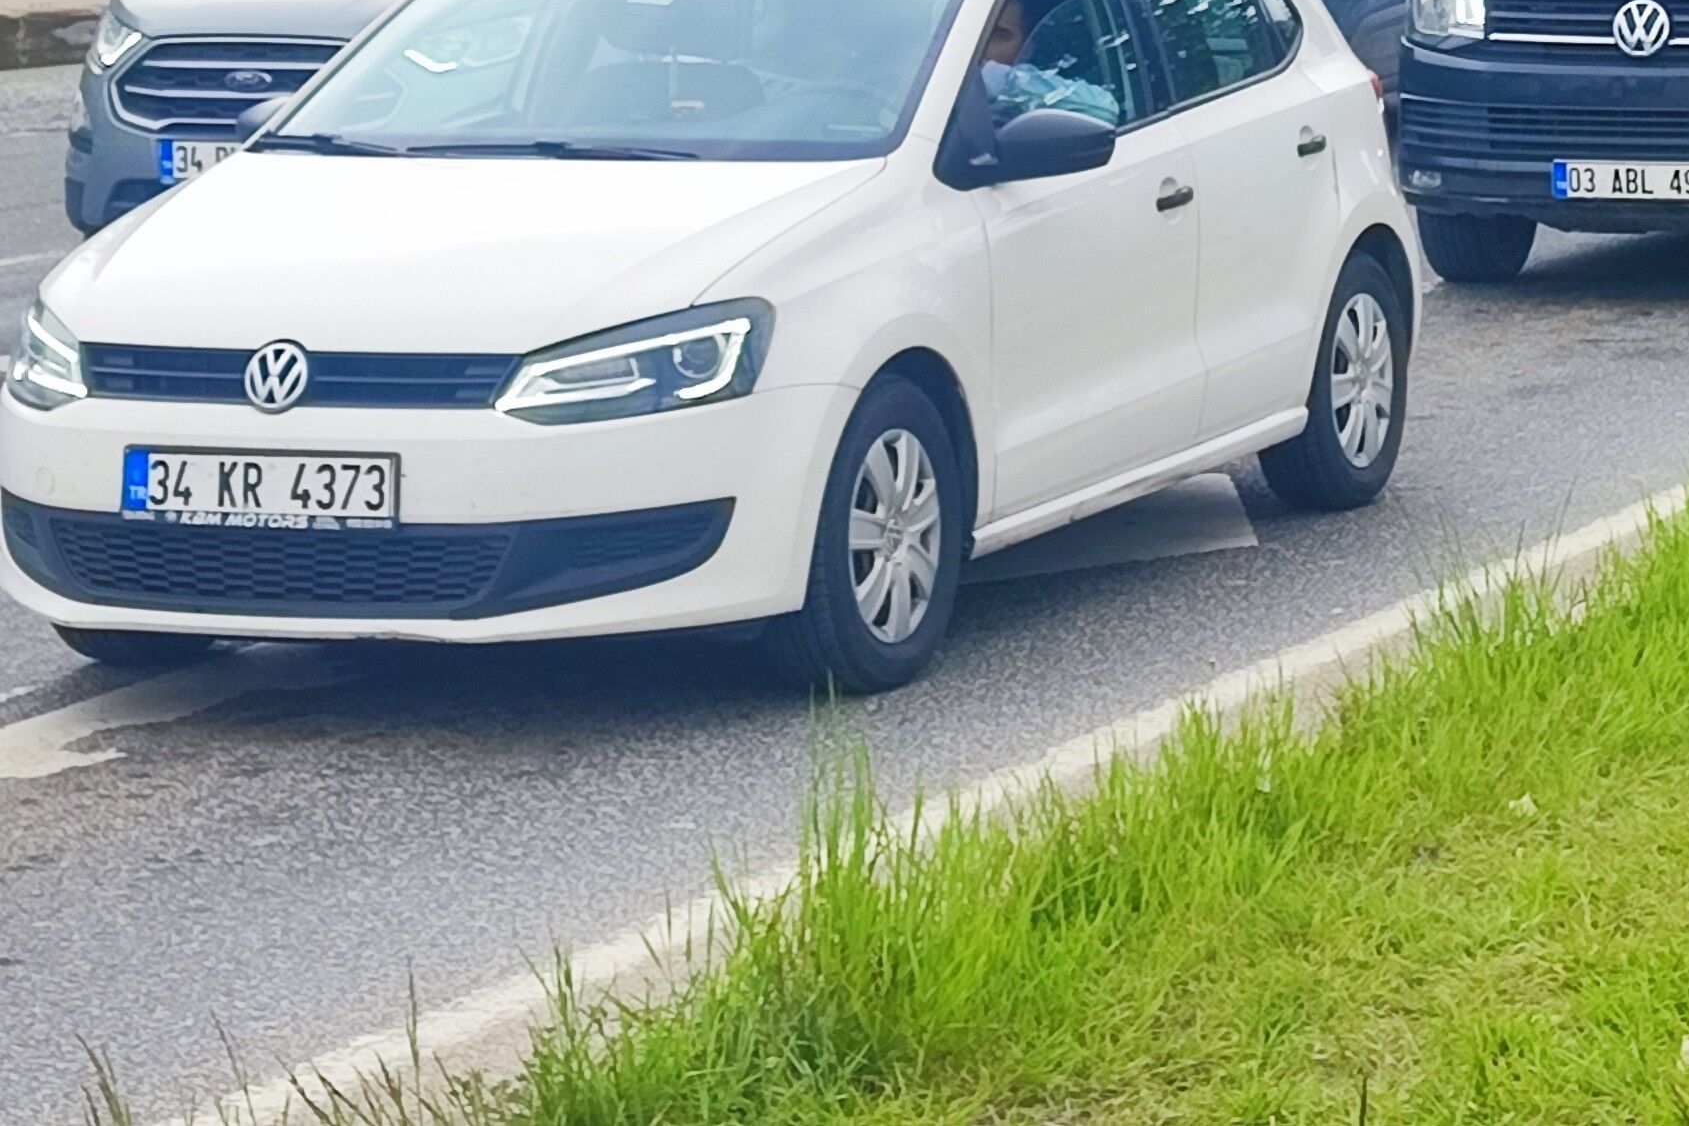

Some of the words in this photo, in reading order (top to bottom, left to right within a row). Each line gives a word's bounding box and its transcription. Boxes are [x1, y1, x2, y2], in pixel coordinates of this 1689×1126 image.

[175, 145, 203, 173] 34
[1568, 167, 1596, 193] 03
[1611, 168, 1654, 194] ABL
[149, 459, 193, 506] 34
[217, 461, 263, 509] KR
[290, 463, 386, 511] 4373
